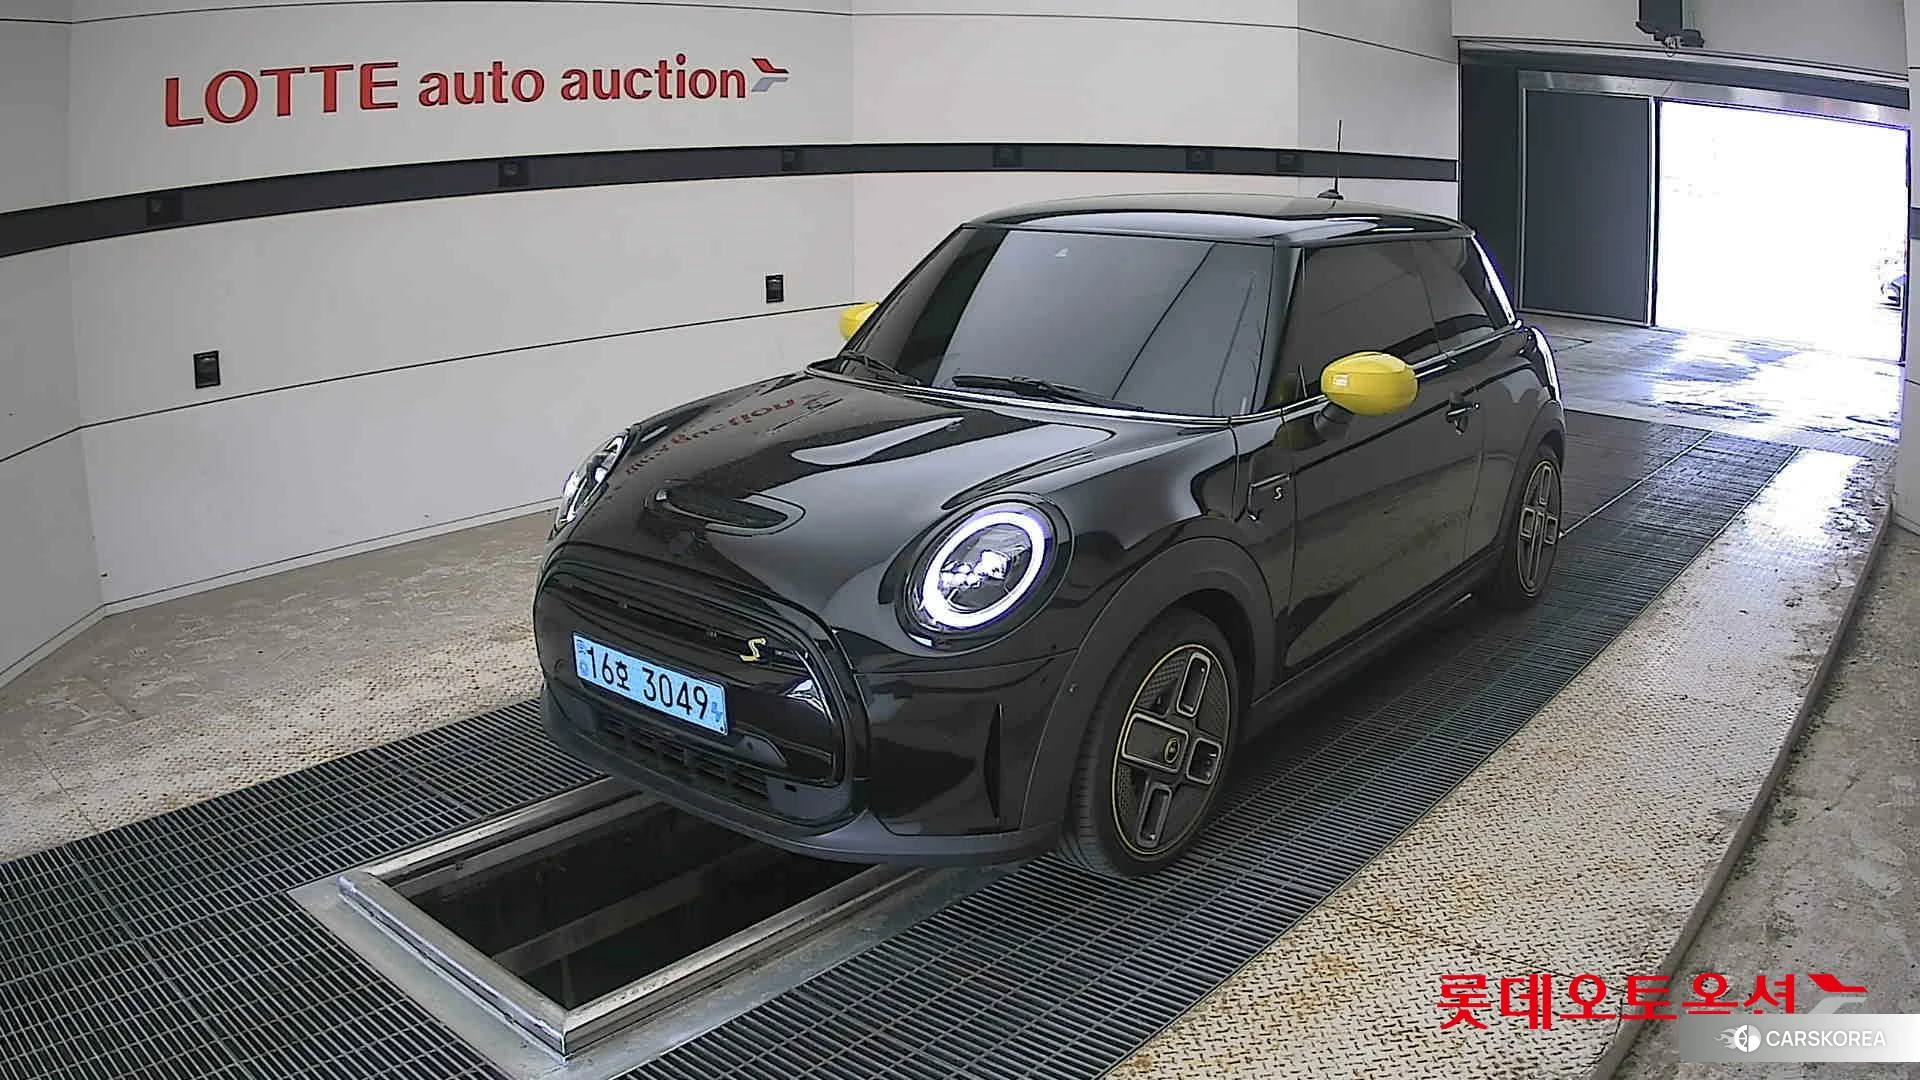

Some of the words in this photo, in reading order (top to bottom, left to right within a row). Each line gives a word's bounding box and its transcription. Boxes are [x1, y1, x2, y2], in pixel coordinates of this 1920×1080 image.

[164, 61, 399, 128] LOTTE
[418, 60, 545, 107] auto
[560, 52, 746, 102] auction
[586, 645, 632, 692] 16호
[641, 666, 709, 720] 3049
[740, 637, 767, 662] S
